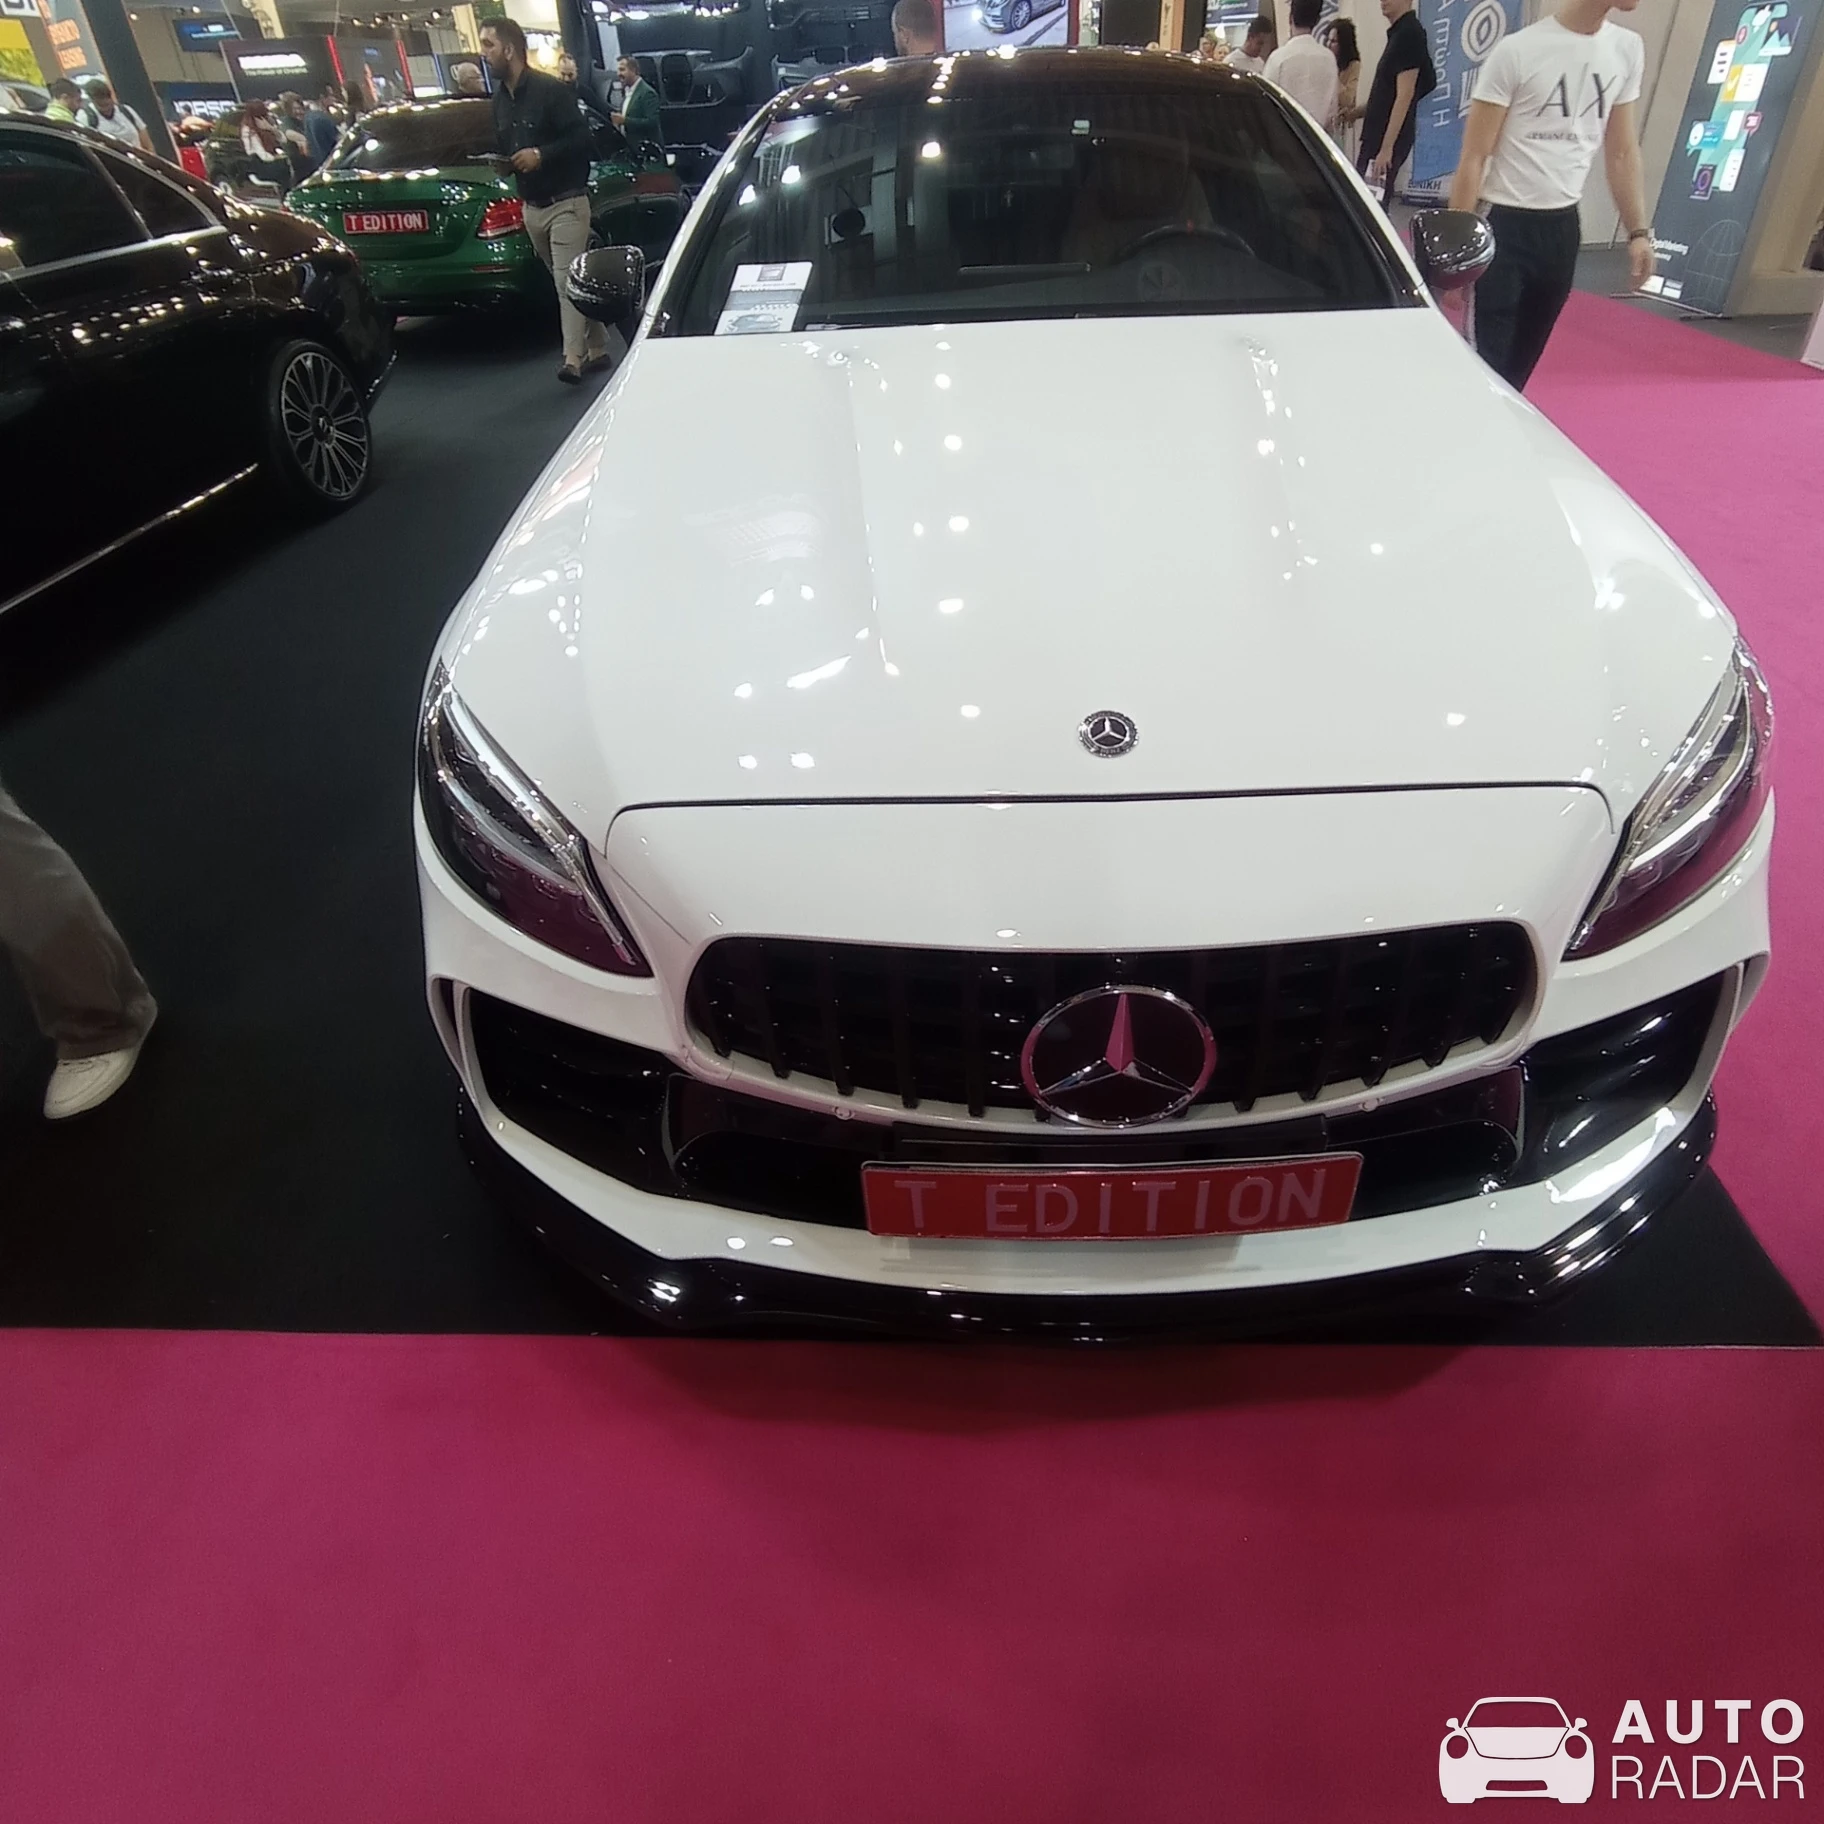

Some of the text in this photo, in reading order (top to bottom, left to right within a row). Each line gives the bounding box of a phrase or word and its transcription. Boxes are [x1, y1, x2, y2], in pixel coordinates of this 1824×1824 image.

[348, 213, 422, 230] T EDITION
[894, 1168, 1327, 1233] T EDITION
